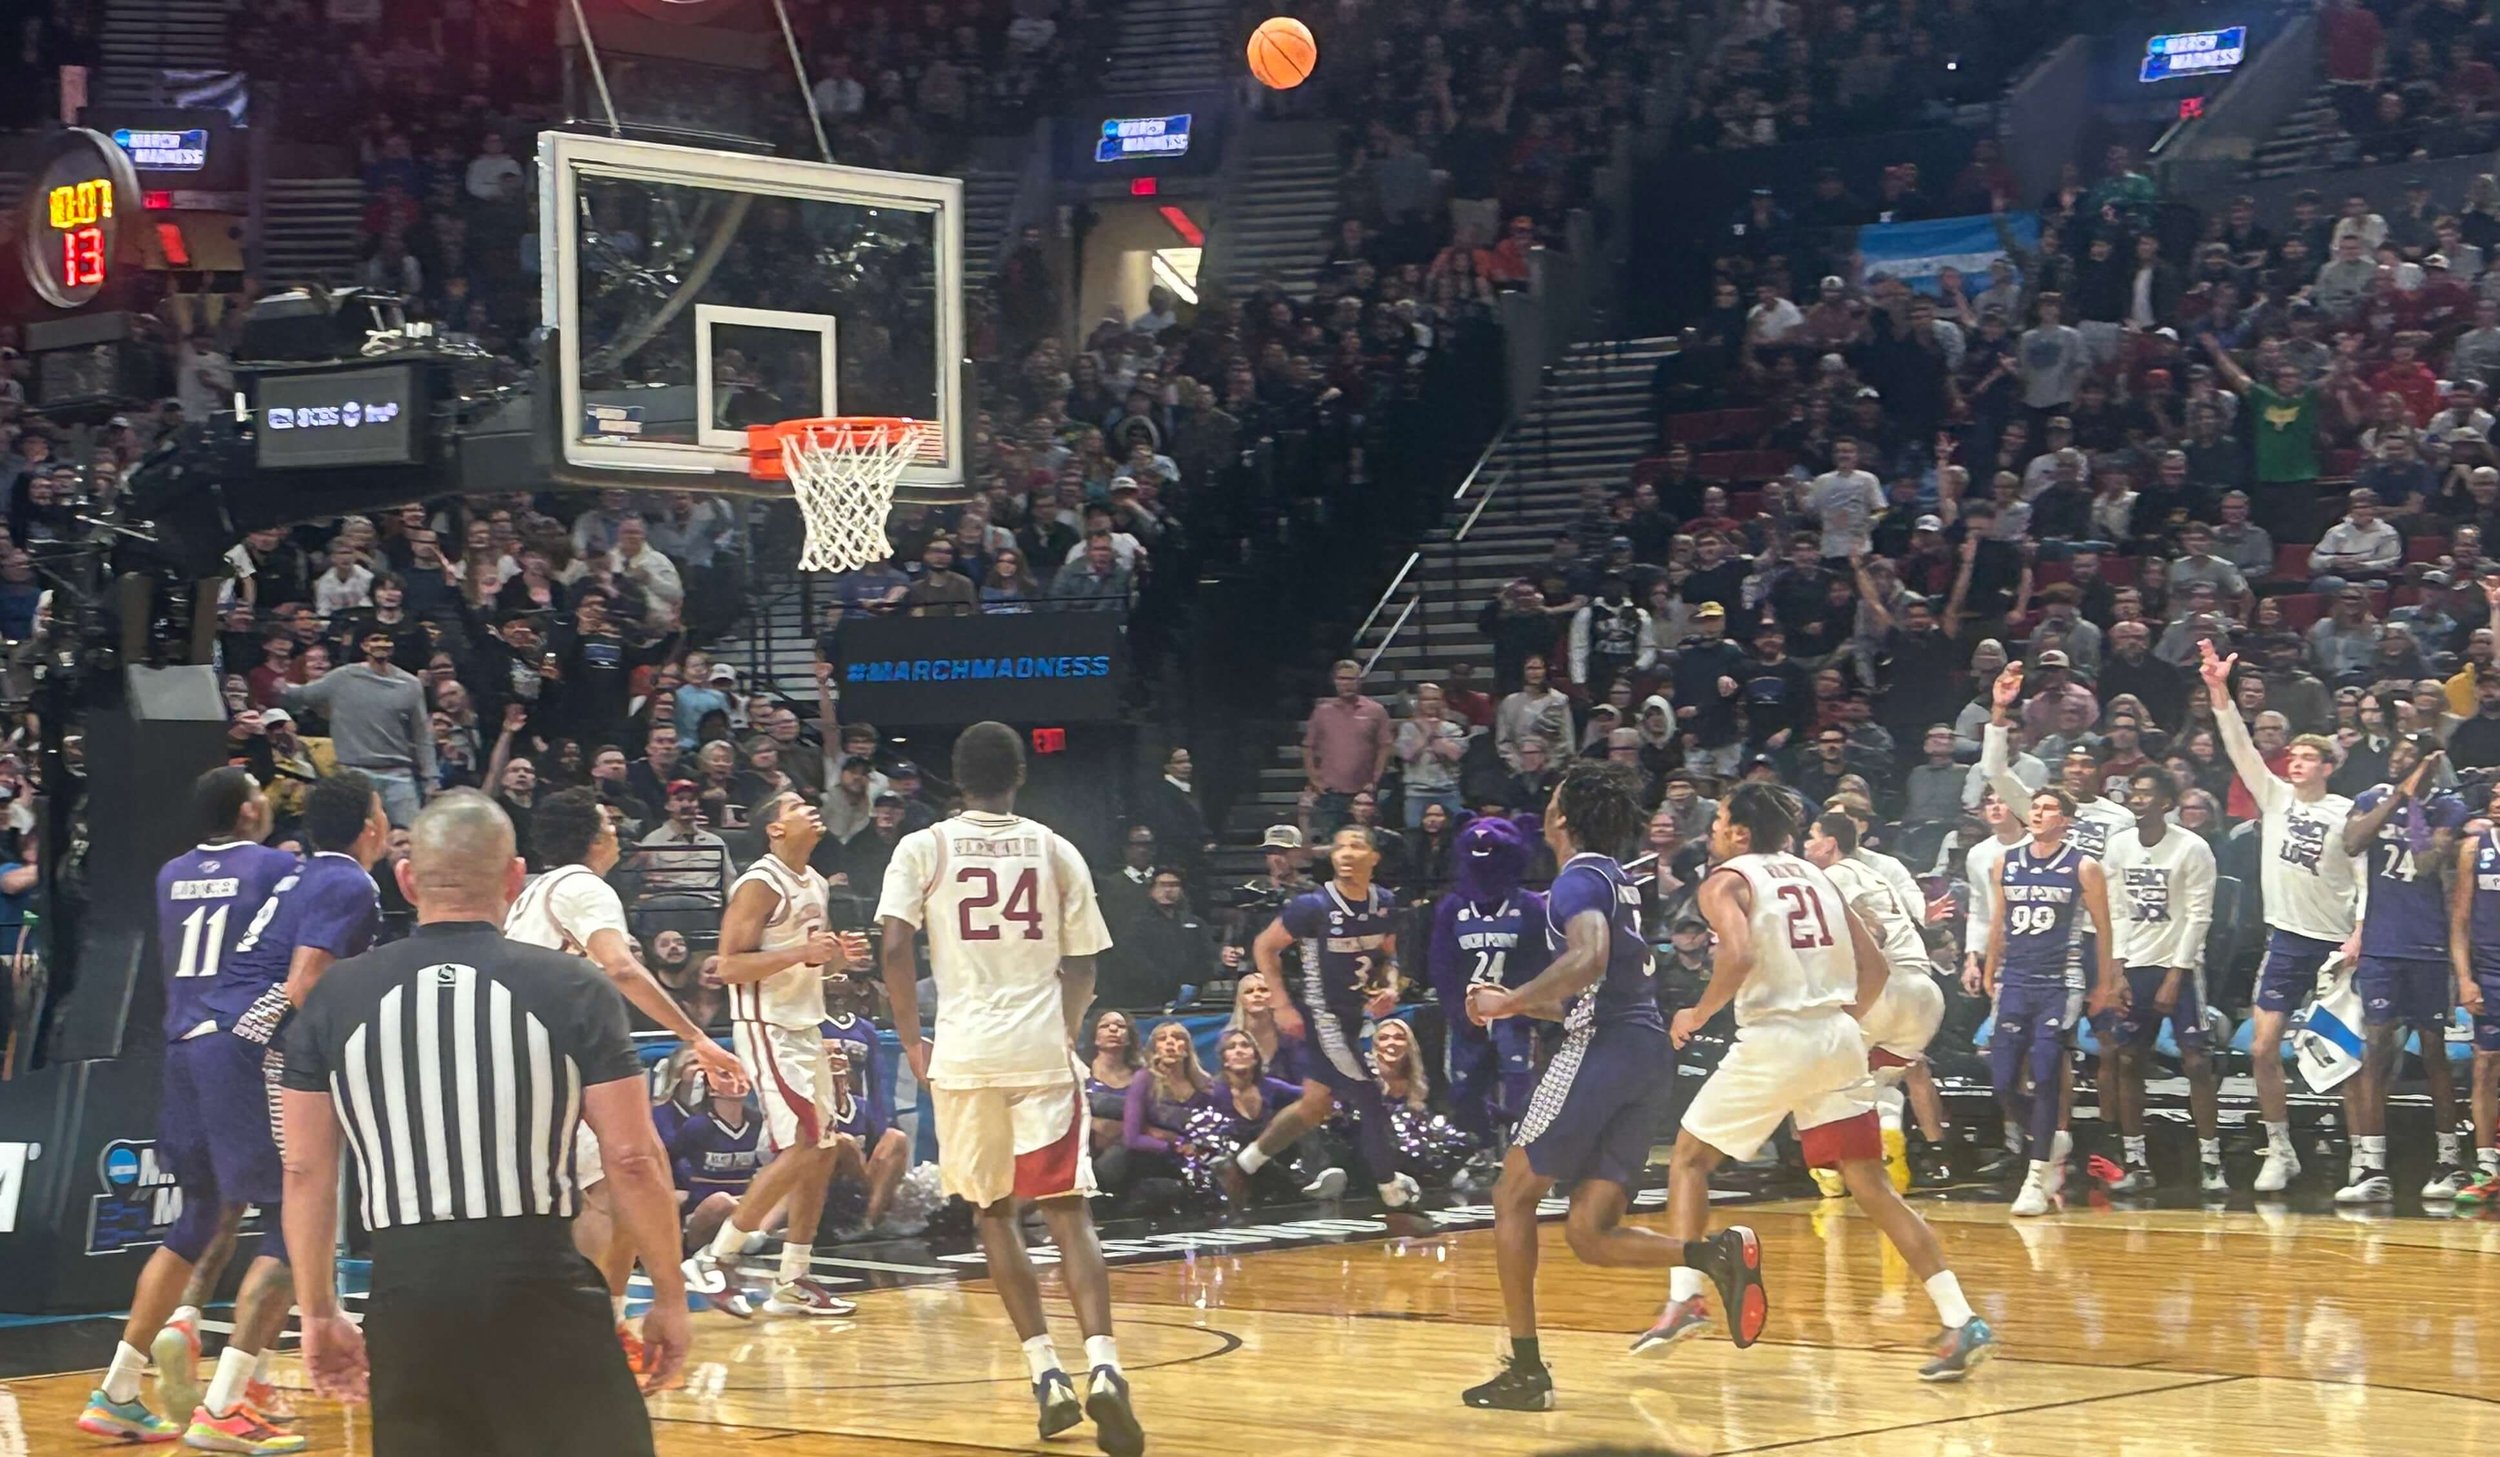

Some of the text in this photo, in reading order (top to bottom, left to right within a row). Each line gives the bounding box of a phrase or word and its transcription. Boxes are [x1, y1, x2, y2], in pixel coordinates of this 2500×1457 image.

[65, 228, 105, 286] 13
[847, 655, 1110, 682] #MARCHMADNESS
[2380, 843, 2418, 882] 24
[957, 867, 1043, 940] 24
[1777, 885, 1835, 949] 21
[2010, 905, 2056, 935] 99
[175, 903, 230, 977] 11
[1470, 951, 1506, 984] 24
